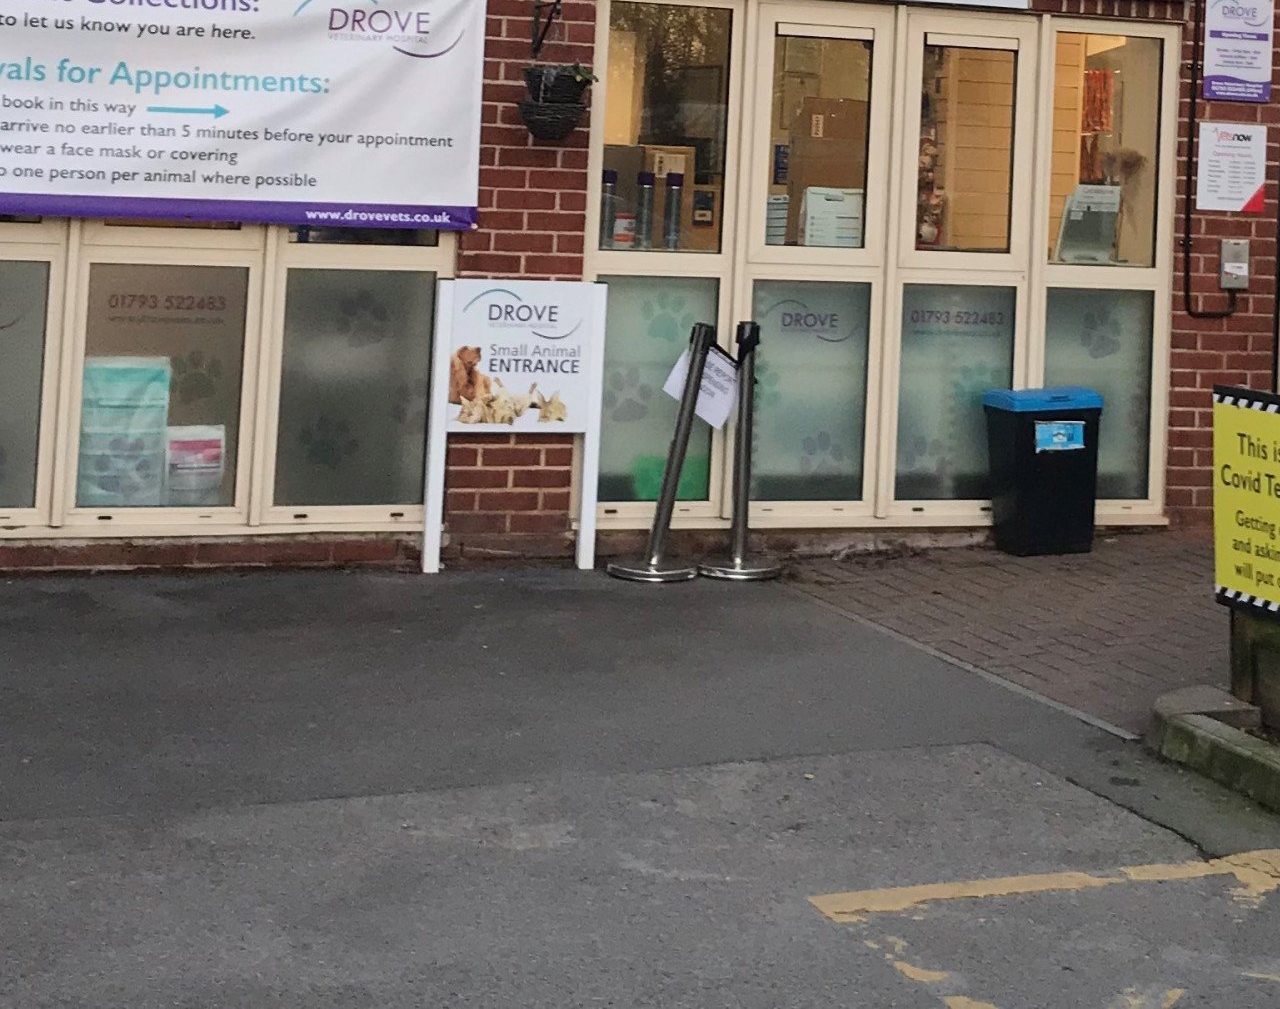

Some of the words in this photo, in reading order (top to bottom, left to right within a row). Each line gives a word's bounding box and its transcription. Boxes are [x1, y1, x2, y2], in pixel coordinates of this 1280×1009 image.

[327, 6, 431, 36] DROVE
[1221, 5, 1258, 18] DROVE
[23, 13, 48, 28] let
[54, 18, 74, 30] us
[80, 16, 132, 33] know
[136, 22, 170, 38] you
[176, 24, 206, 37] are
[211, 23, 256, 40] here.
[57, 57, 102, 84] for
[109, 60, 331, 94] Appointments:
[1, 95, 45, 110] book
[49, 97, 65, 111] in
[69, 97, 99, 113] this
[104, 102, 137, 118] way
[0, 119, 50, 133] arrive
[55, 122, 76, 134] no
[81, 121, 135, 136] earlier
[140, 124, 176, 138] than
[181, 124, 191, 138] 5
[196, 126, 260, 141] minutes
[263, 128, 314, 143] before
[317, 131, 354, 147] your
[357, 133, 454, 149] appointment
[0, 143, 40, 155] wear
[46, 145, 56, 156] a
[61, 142, 95, 158] face
[99, 144, 142, 159] mask
[146, 148, 166, 161] or
[169, 147, 239, 166] covering
[12, 167, 44, 179] one
[49, 168, 106, 182] person
[110, 169, 141, 185] per
[143, 169, 197, 184] animal
[201, 170, 251, 186] where
[255, 172, 318, 189] possible
[305, 208, 451, 224] www.drovevets.co.uk
[108, 293, 160, 310] 01793
[488, 303, 560, 323] DROVE
[780, 312, 840, 329] DROVE
[490, 342, 528, 358] Small
[530, 344, 582, 359] Animal
[488, 357, 581, 374] ENTRANCE
[1236, 432, 1269, 461] This
[1220, 463, 1262, 495] Covid
[1234, 509, 1276, 541] Getting
[1232, 537, 1252, 555] and
[1233, 561, 1254, 581] will
[1254, 569, 1275, 588] put
